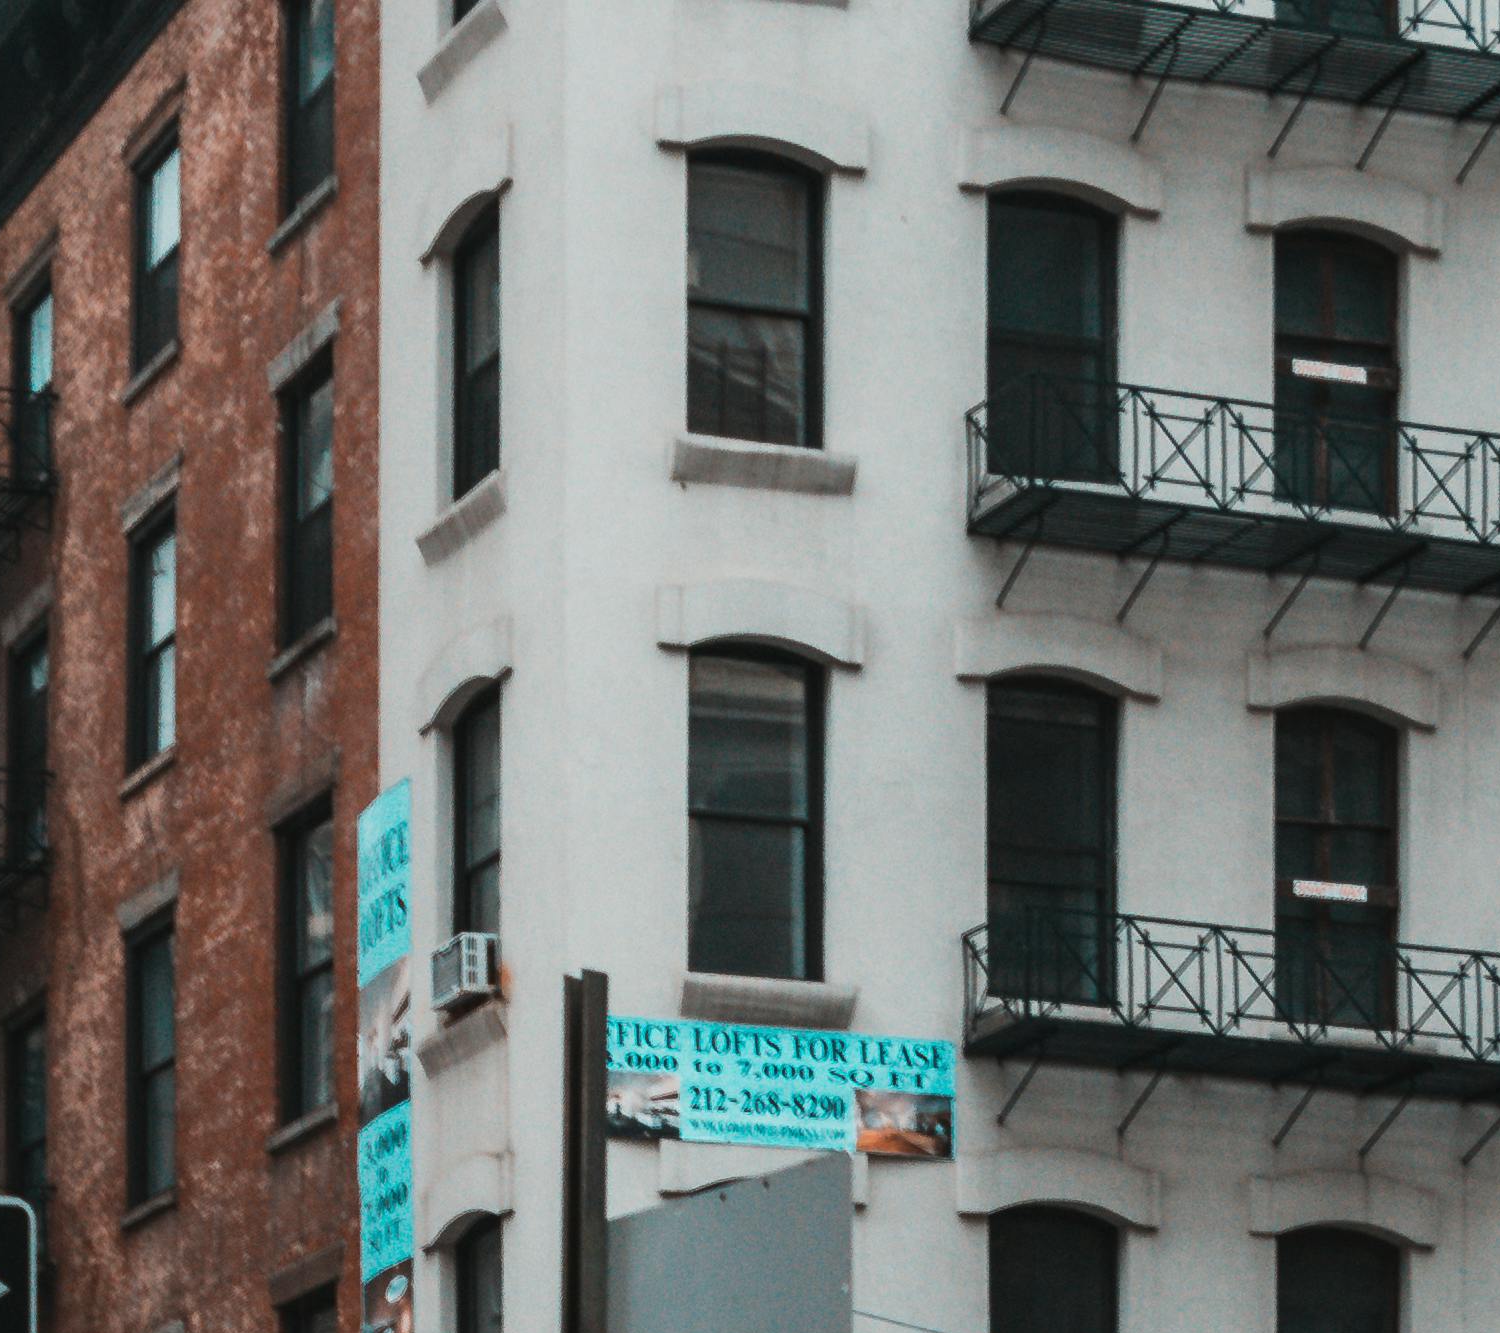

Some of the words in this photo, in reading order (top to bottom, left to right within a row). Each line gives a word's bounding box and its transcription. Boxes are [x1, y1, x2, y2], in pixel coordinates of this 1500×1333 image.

[693, 1026, 781, 1057] LOFTS
[792, 1034, 847, 1063] FOR
[857, 1039, 947, 1071] LEASE
[693, 1059, 723, 1076] to
[827, 1067, 874, 1088] SQ
[888, 1070, 927, 1089] FT
[688, 1085, 846, 1121] 212-268-8290
